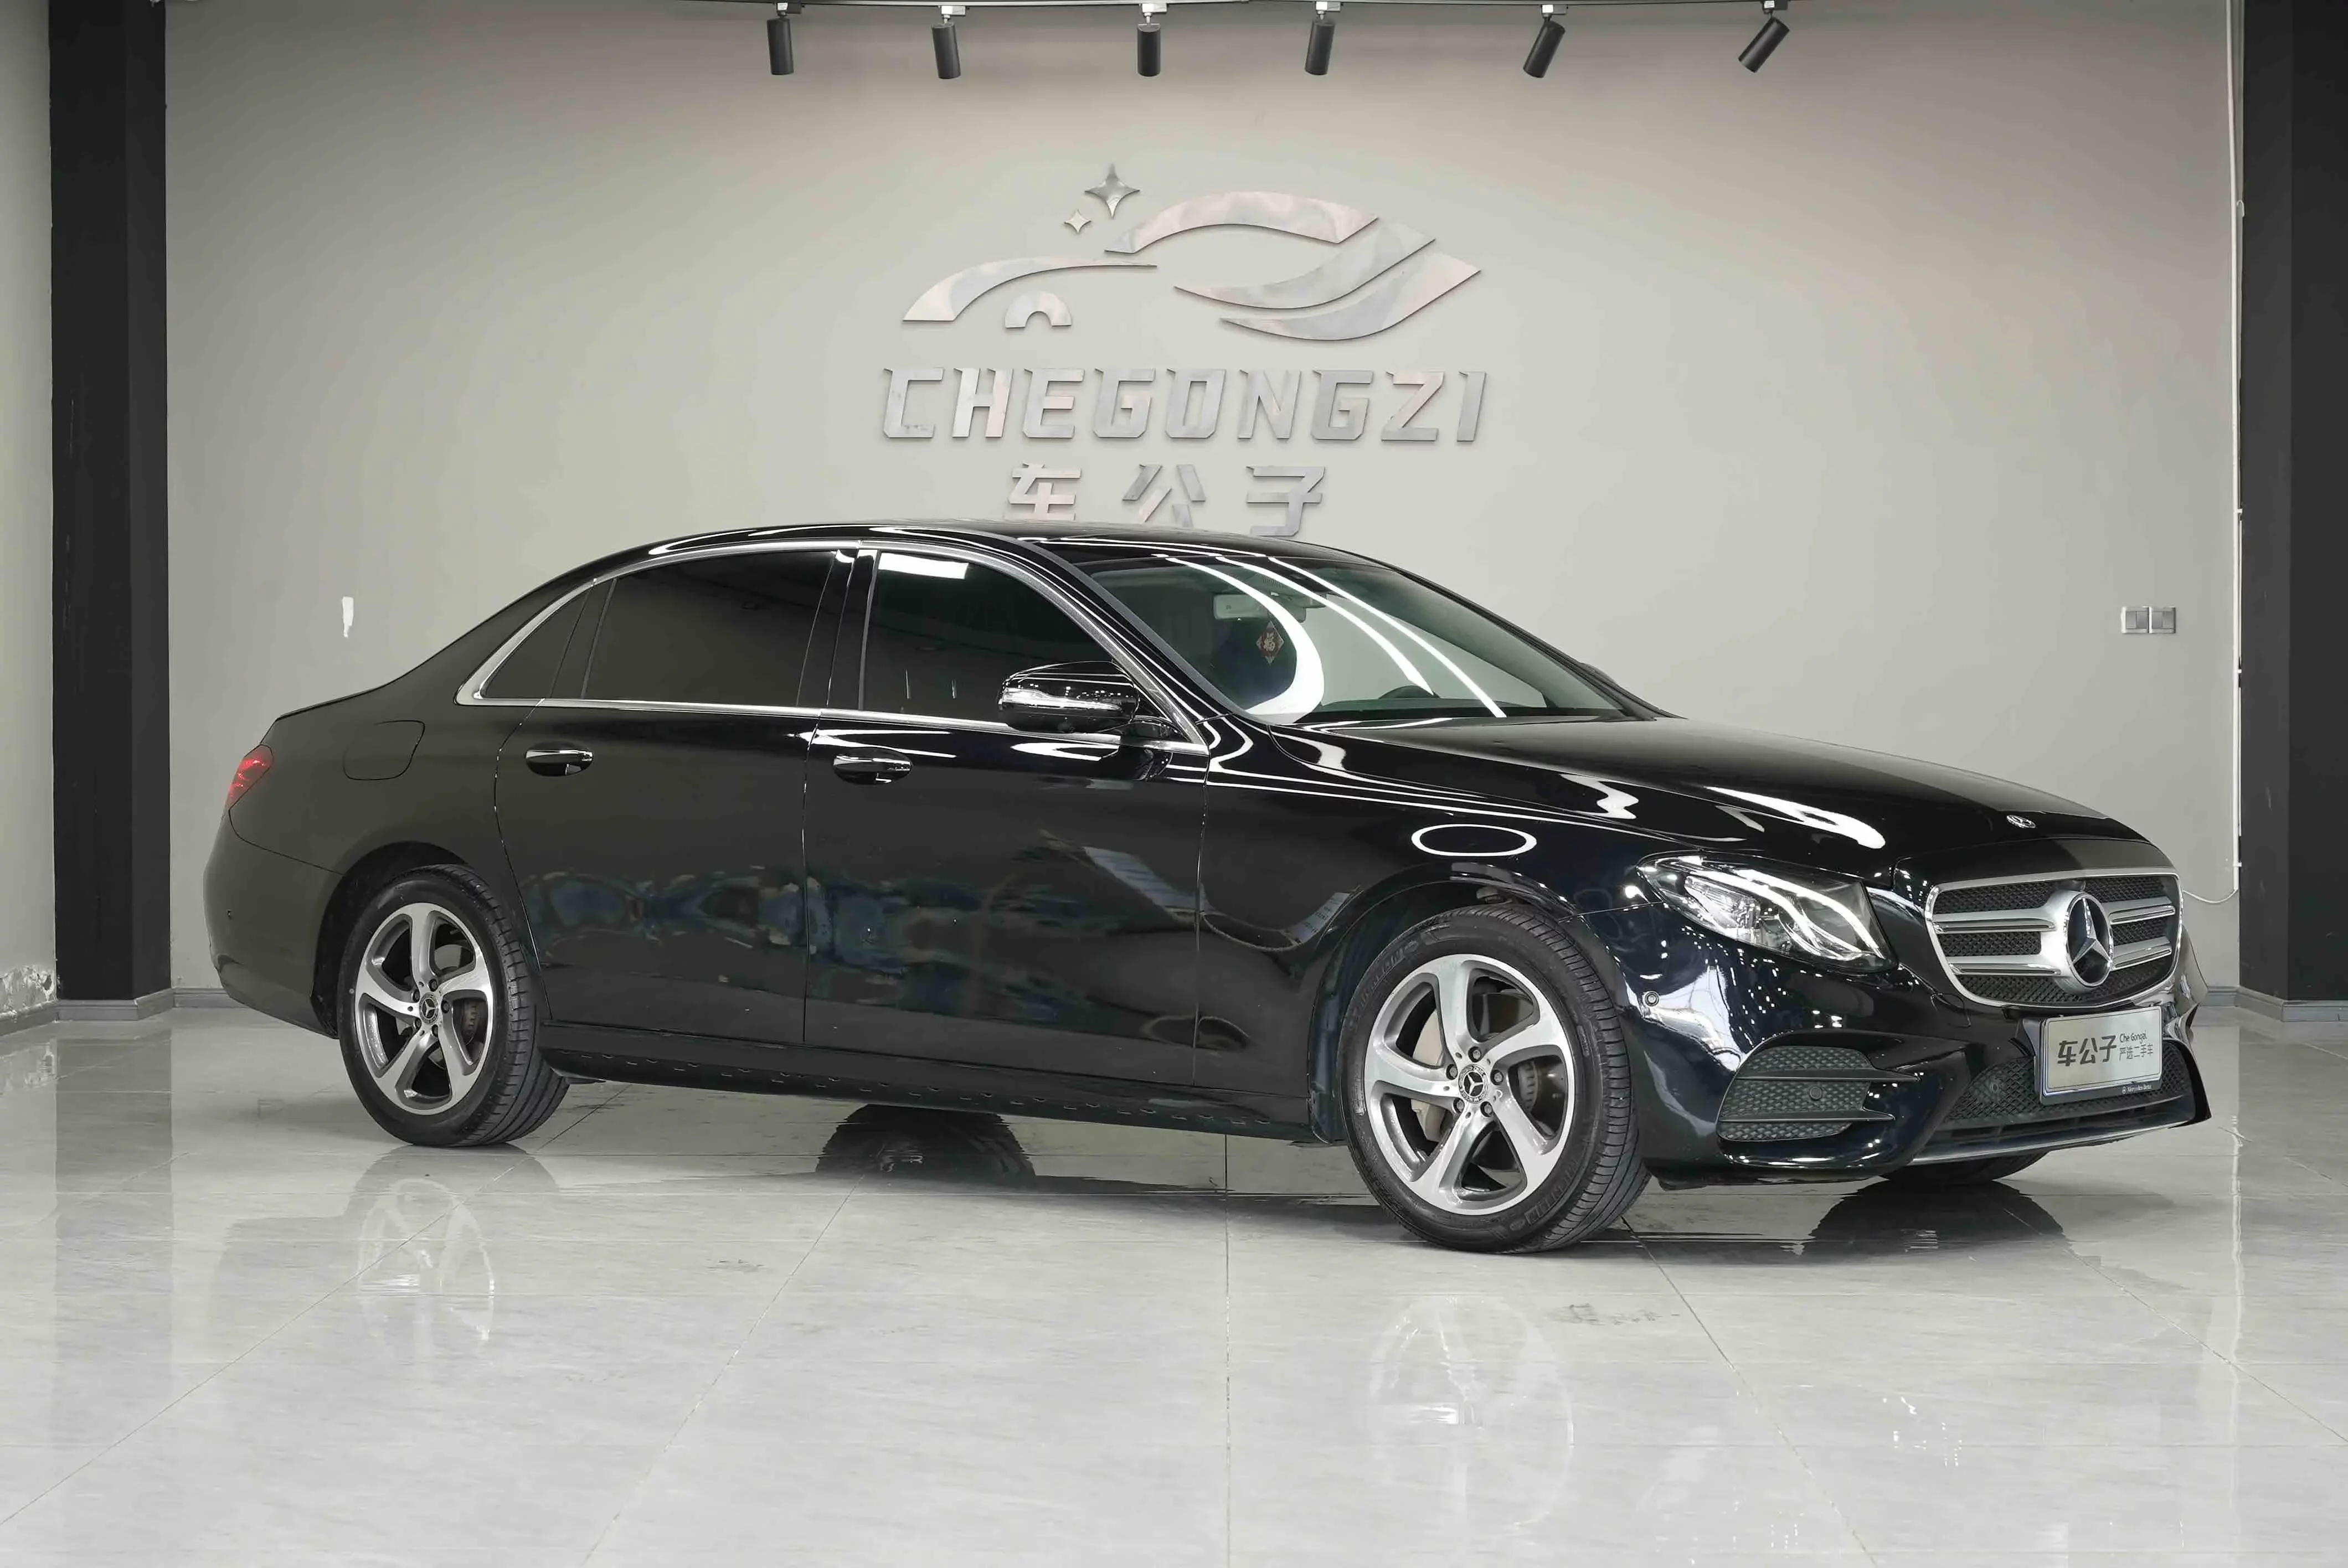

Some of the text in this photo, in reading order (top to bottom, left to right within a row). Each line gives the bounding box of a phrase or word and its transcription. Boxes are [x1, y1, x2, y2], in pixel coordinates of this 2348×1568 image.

[883, 368, 1487, 442] CHEGONGZI
[1004, 463, 1325, 537] 车公子
[2057, 1035, 2117, 1066] 车公子
